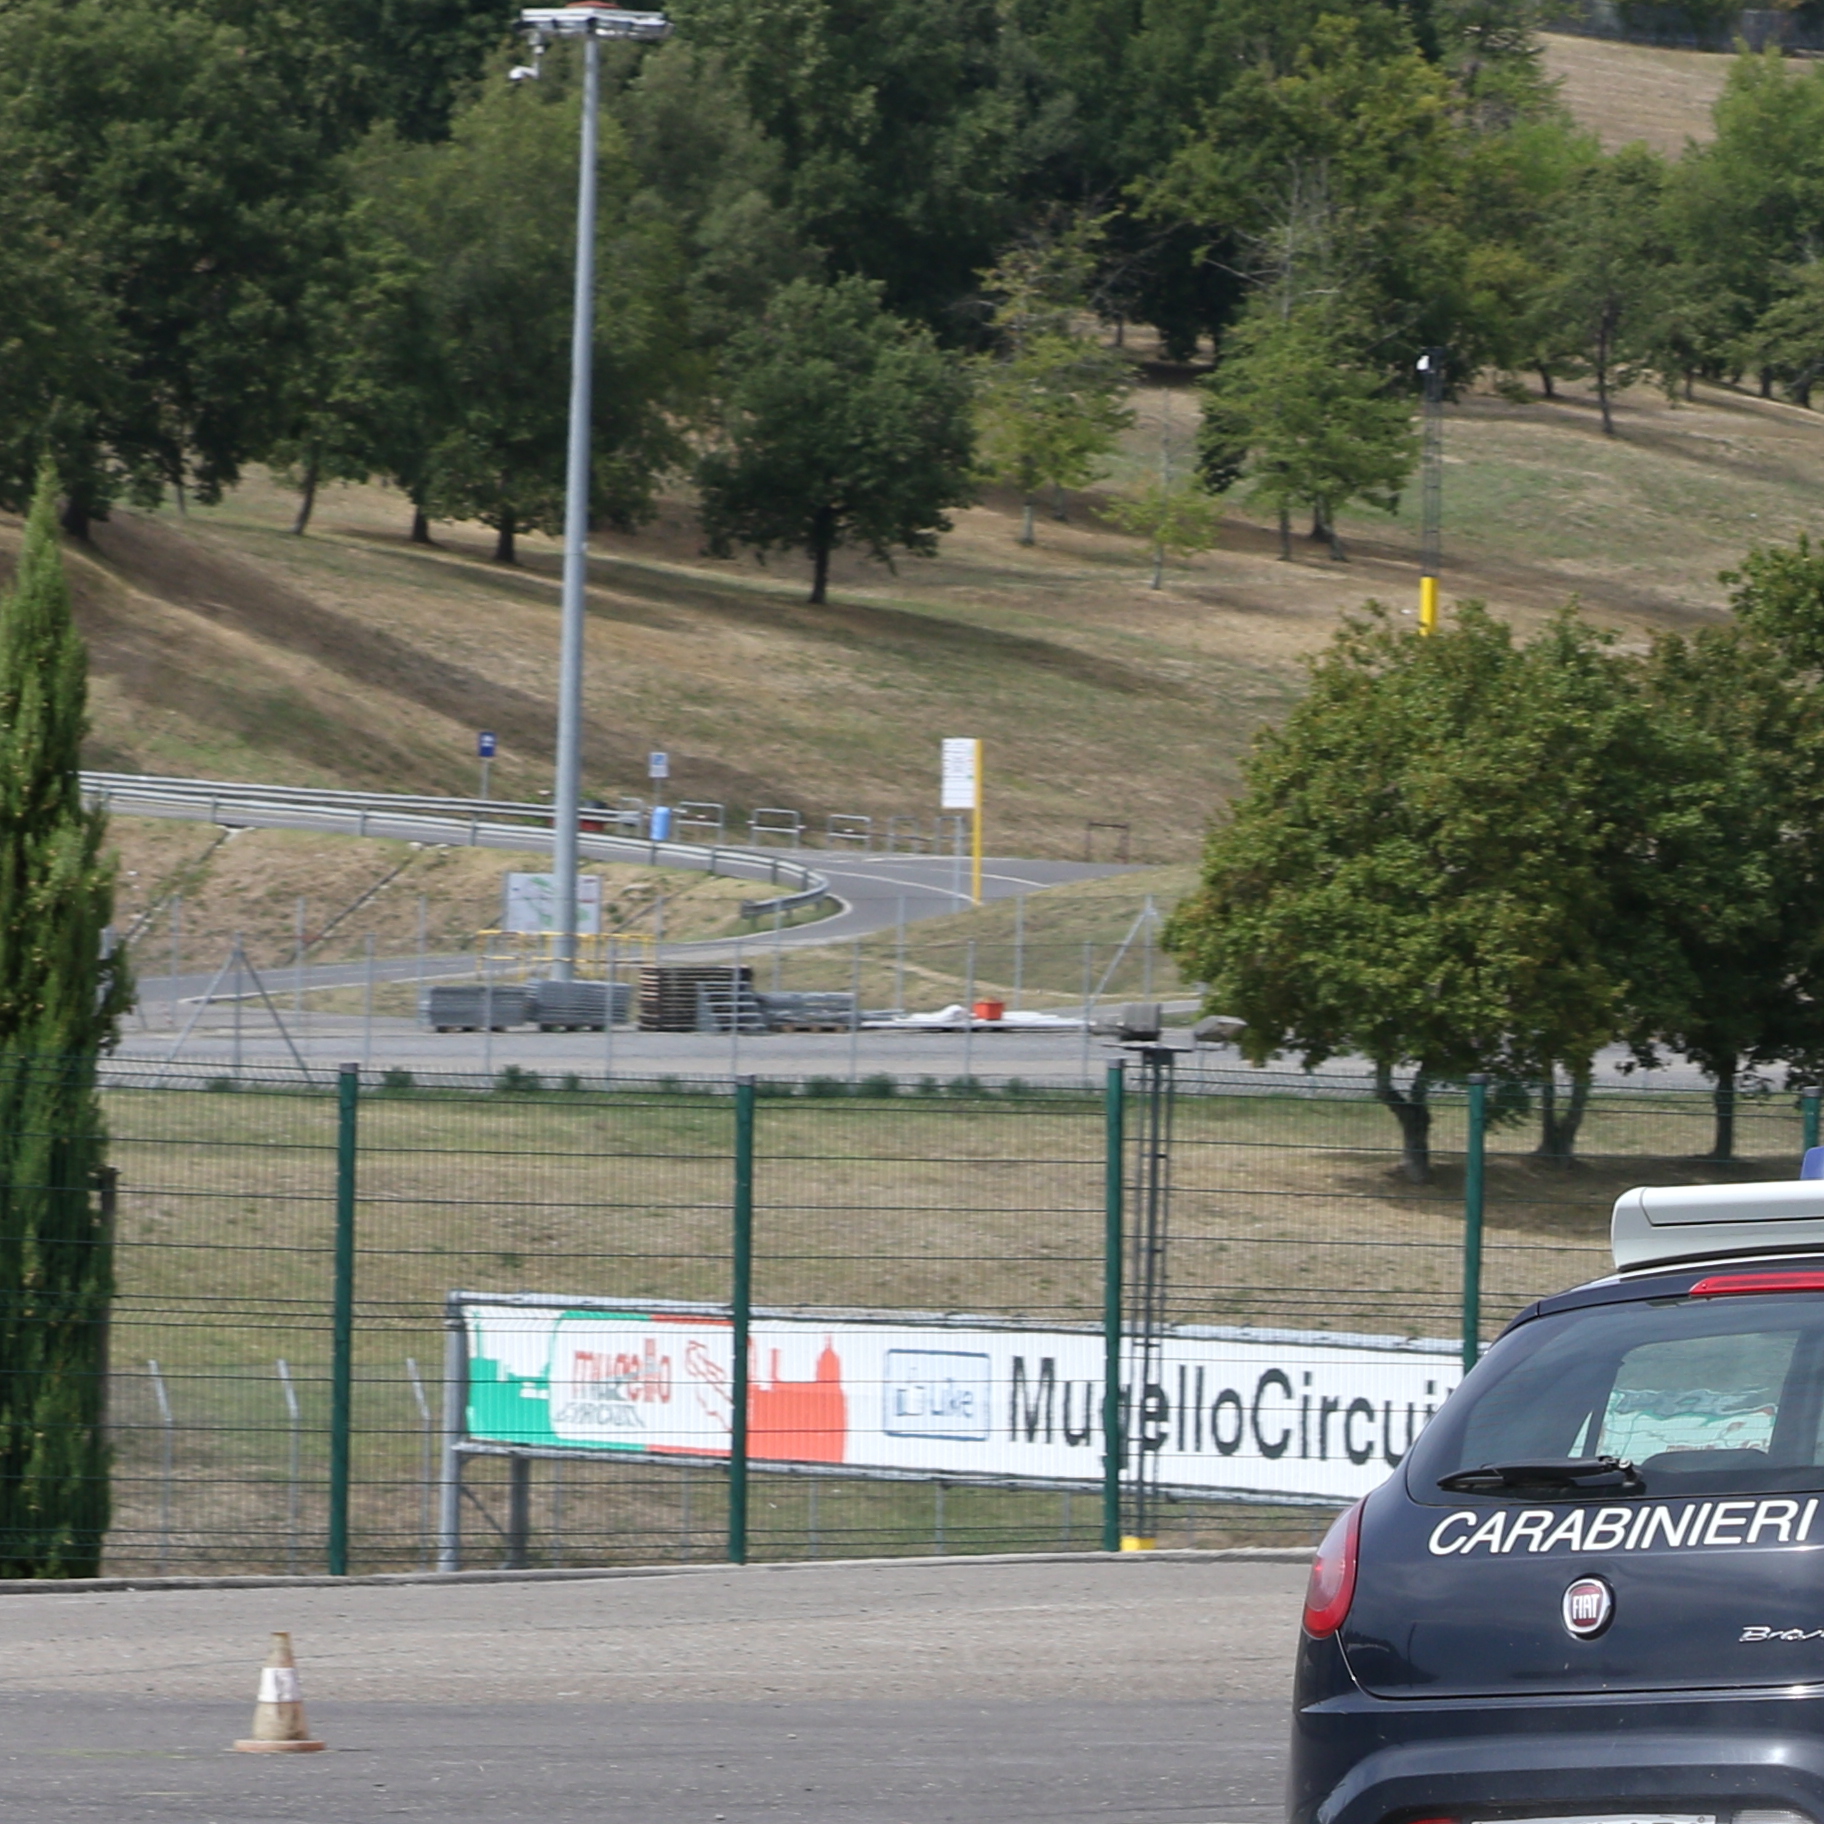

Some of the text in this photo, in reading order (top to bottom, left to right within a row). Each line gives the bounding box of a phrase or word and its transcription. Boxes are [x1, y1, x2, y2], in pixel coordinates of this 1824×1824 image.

[1011, 1355, 1455, 1470] MuelloCircu
[1428, 1498, 1820, 1556] CARABINIERI
[1572, 1593, 1601, 1621] FIAT
